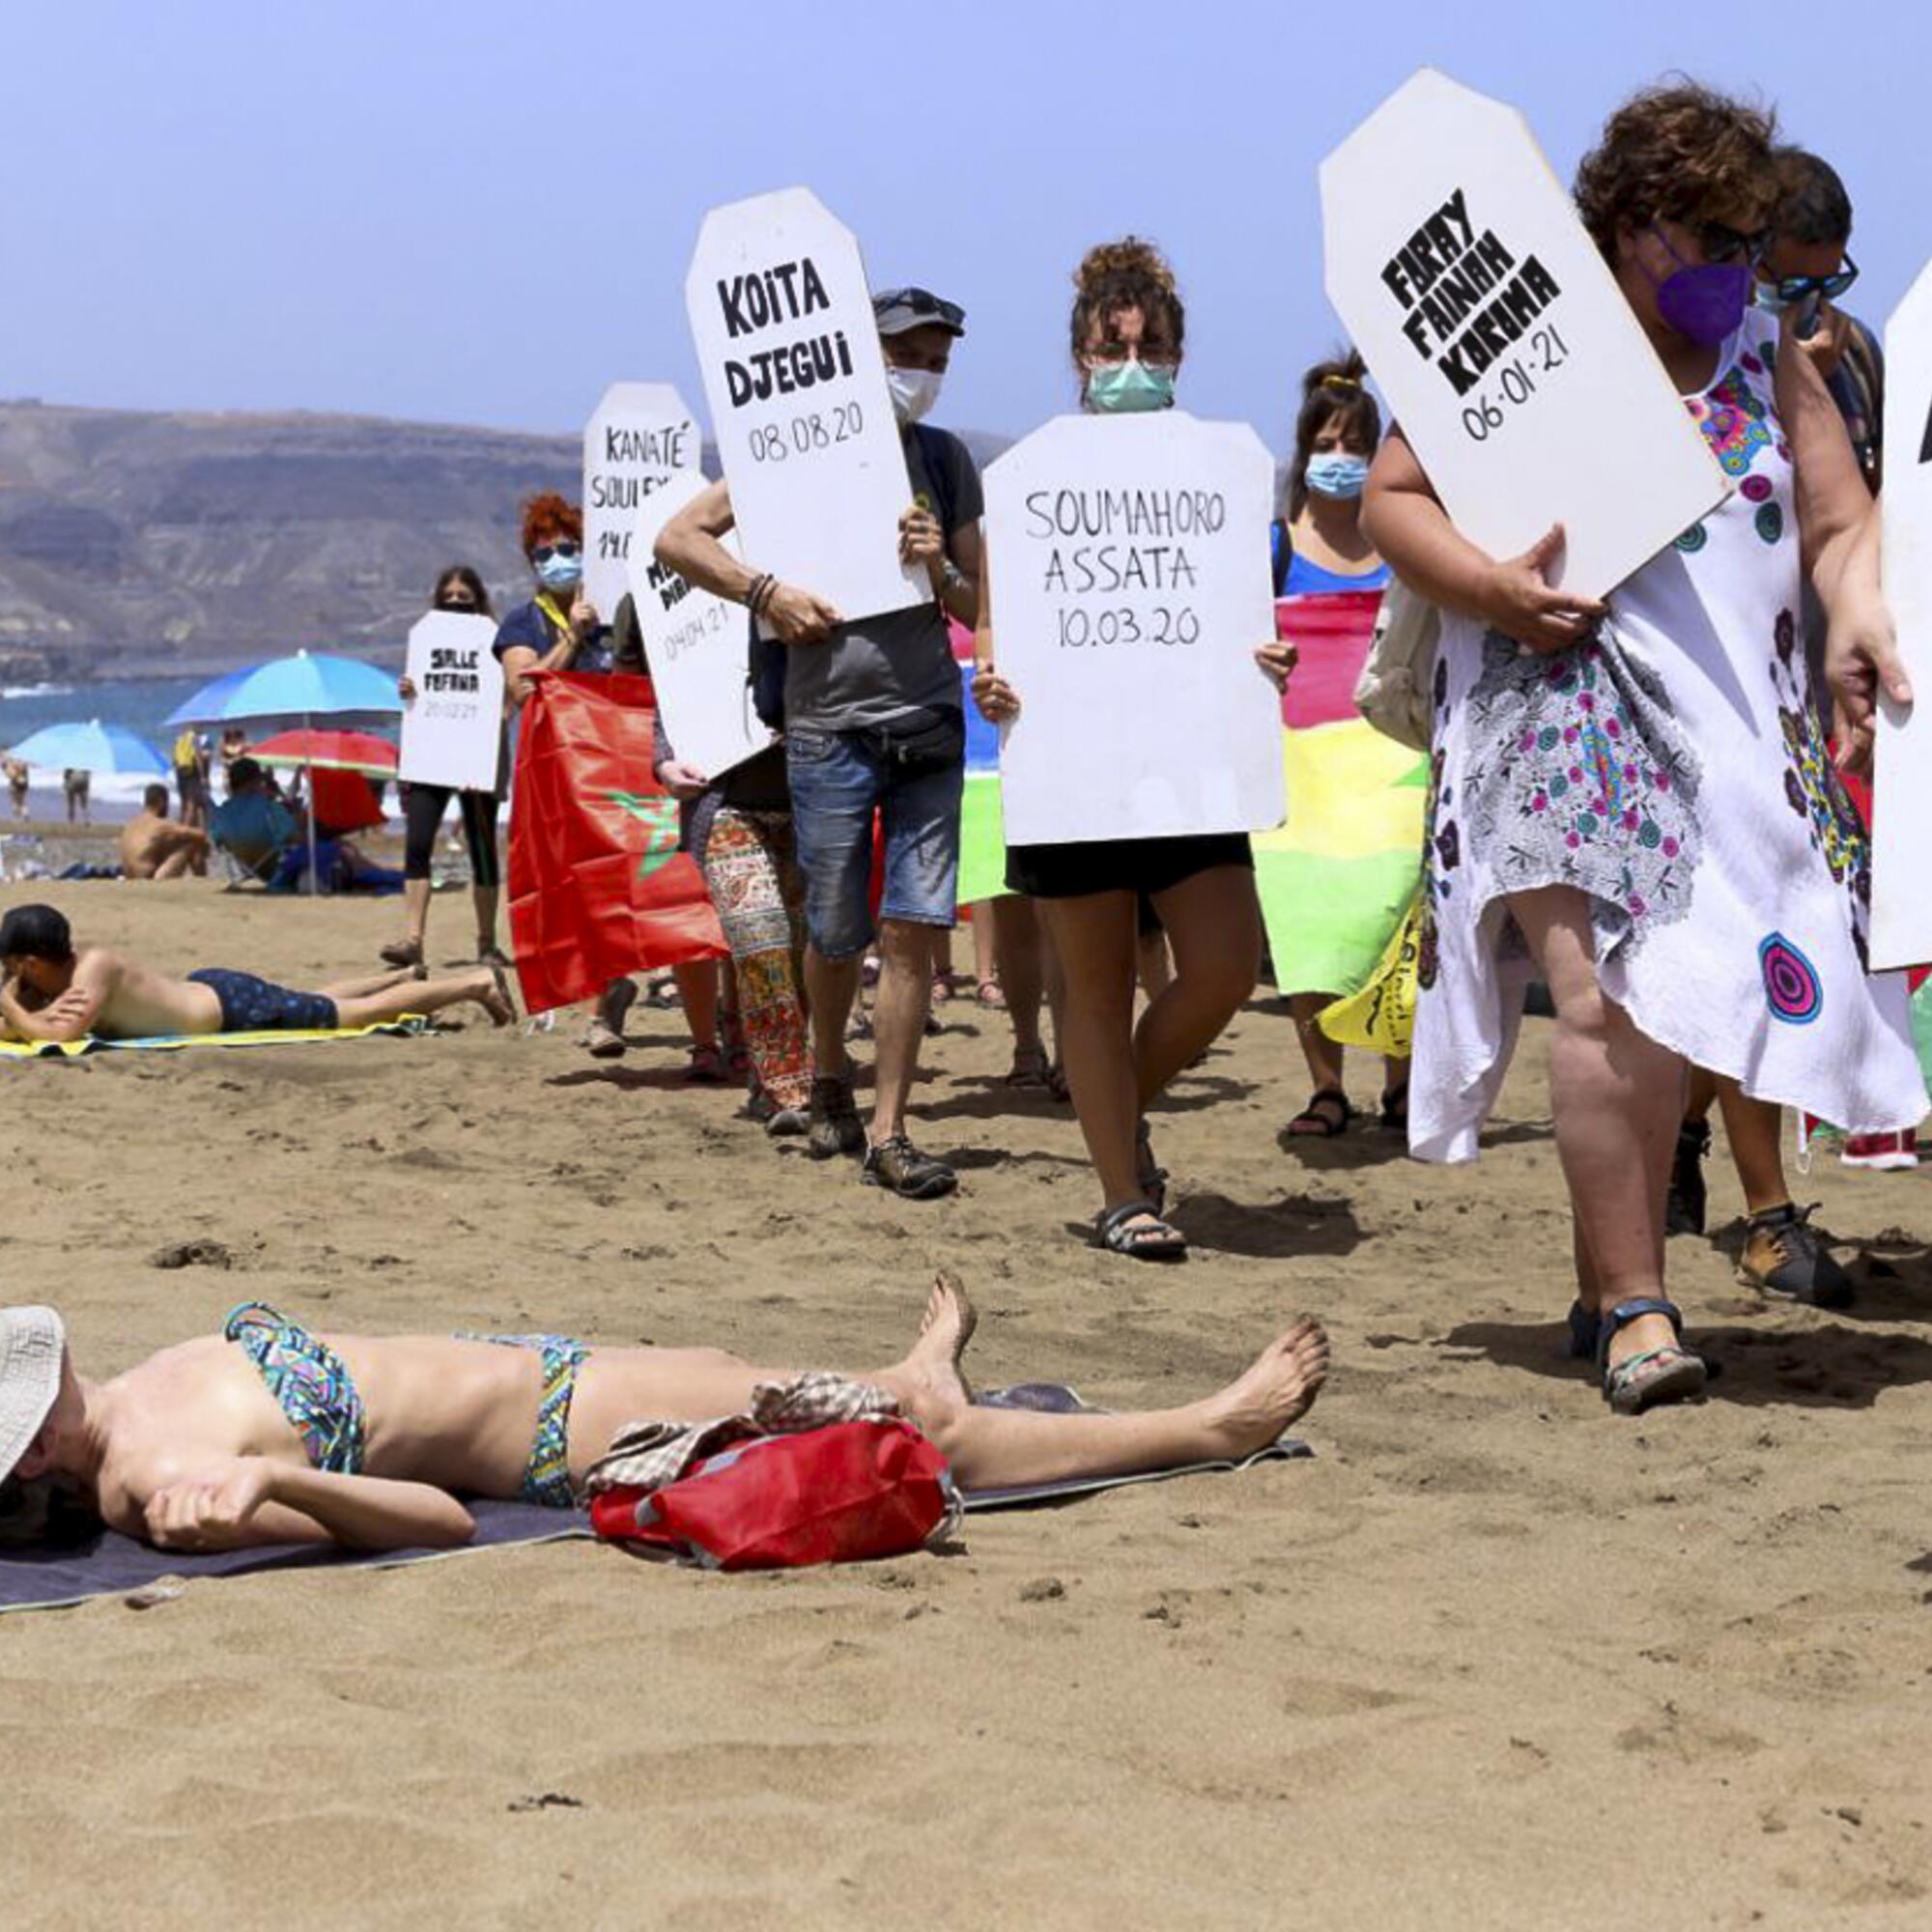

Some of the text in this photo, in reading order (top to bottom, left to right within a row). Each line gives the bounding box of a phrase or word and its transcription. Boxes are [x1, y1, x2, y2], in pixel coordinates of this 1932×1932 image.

[1402, 229, 1516, 360] FAINAH
[606, 419, 691, 469] KANATÉ
[1025, 489, 1226, 539] SOUMAHORO
[1044, 546, 1197, 594] ASSATA
[1058, 607, 1201, 648] 10.03.20
